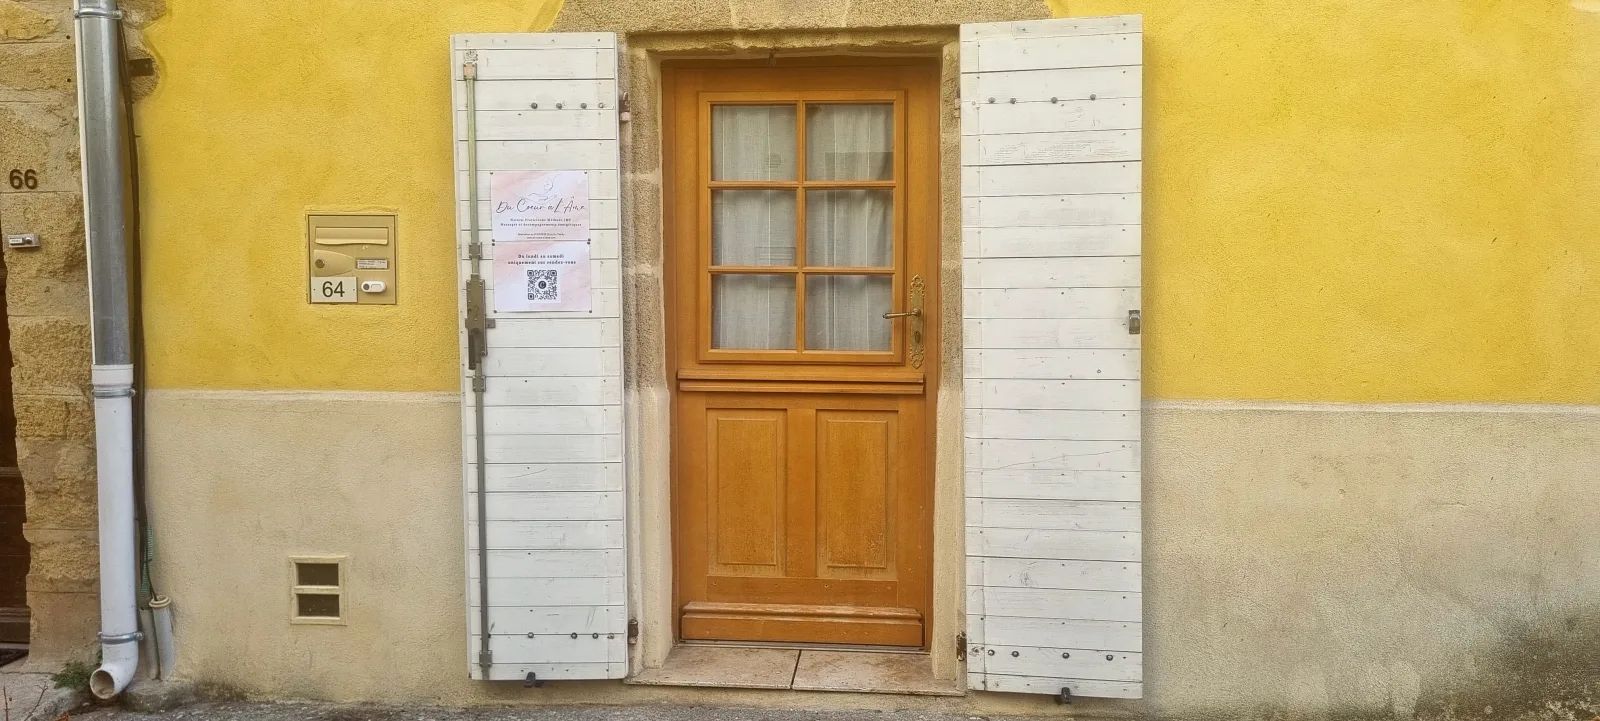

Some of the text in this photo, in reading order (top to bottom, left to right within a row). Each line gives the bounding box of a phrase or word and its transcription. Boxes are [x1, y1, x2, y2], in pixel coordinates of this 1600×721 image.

[9, 168, 38, 190] 66
[496, 200, 514, 214] Du
[516, 198, 545, 213] Coeur
[322, 280, 345, 298] 64
